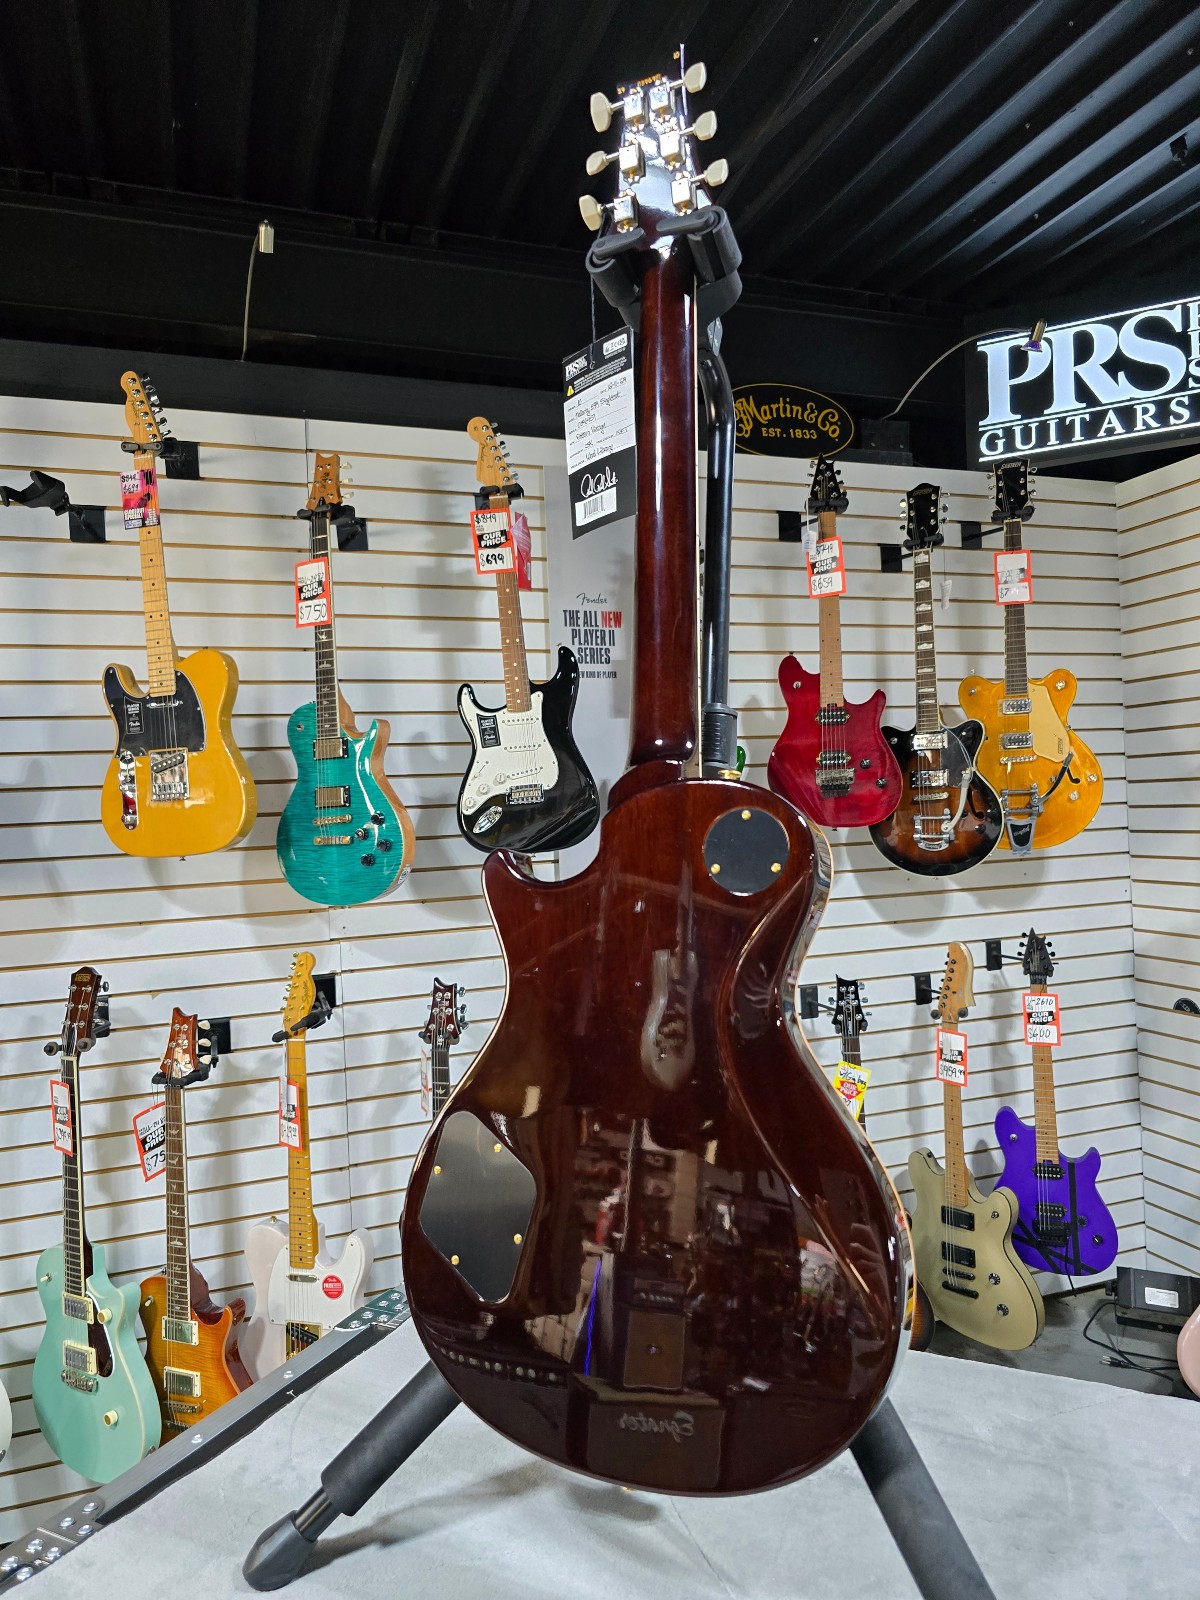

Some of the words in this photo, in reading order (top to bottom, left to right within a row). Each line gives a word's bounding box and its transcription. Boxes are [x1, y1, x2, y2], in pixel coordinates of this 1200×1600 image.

[977, 305, 1186, 426] PRS
[979, 396, 1191, 456] GUITARS
[761, 427, 787, 438] EST.
[790, 428, 818, 439] 1833
[475, 513, 497, 525] $849
[480, 536, 507, 548] PRICE
[482, 531, 502, 541] OUR
[479, 553, 505, 567] $699
[815, 558, 833, 568] OUR
[813, 562, 838, 574] PRICE
[300, 586, 323, 600] PRICE
[302, 582, 319, 593] OUR
[576, 592, 608, 606] Fender
[299, 603, 327, 621] $750
[562, 609, 580, 627] THE
[582, 610, 599, 628] ALL
[601, 611, 622, 628] NEW
[571, 628, 607, 646] PLAYER
[608, 629, 616, 646] II
[577, 646, 611, 664] SERIES
[1029, 1015, 1054, 1024] PRICE
[1027, 1027, 1051, 1039] $600
[839, 1085, 858, 1097] PRICE
[843, 1081, 857, 1090] OUR
[146, 1126, 165, 1143] OUR
[144, 1133, 166, 1152] PRIC
